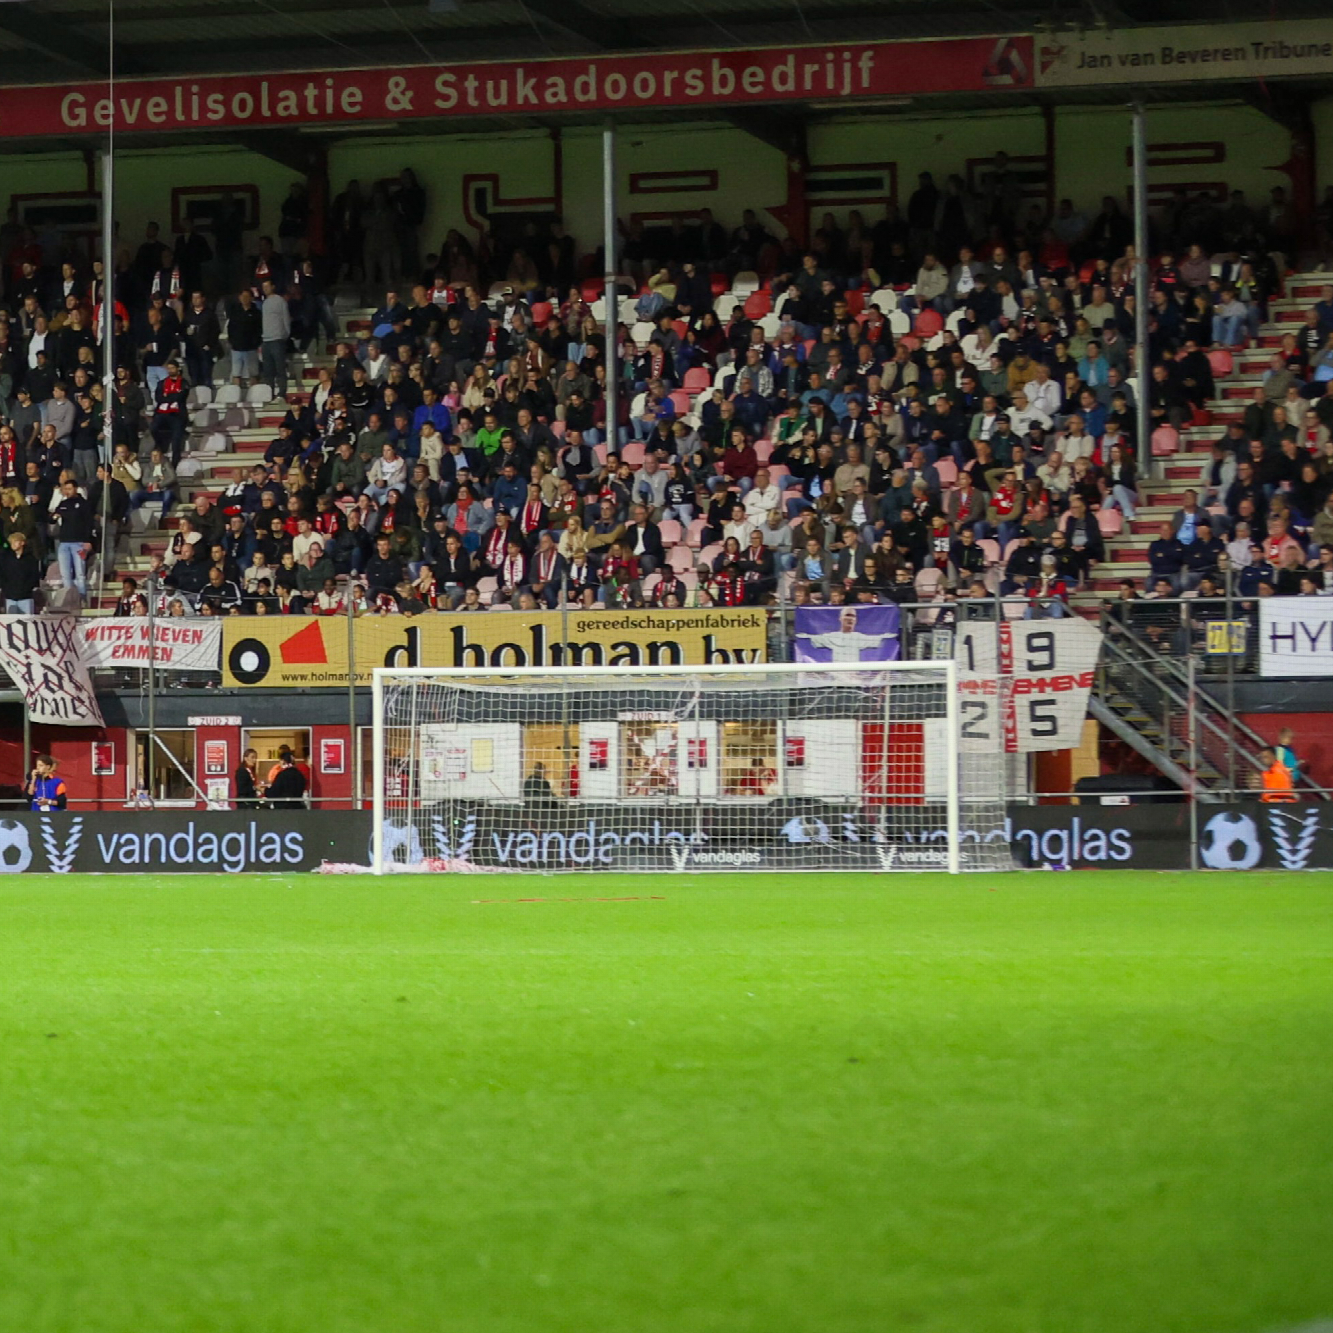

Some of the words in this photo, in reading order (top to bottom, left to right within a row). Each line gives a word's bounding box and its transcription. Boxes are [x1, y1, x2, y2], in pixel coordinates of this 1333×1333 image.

[1077, 51, 1111, 69] Jan
[1118, 52, 1155, 67] van
[1161, 43, 1247, 65] Beveren
[1250, 40, 1333, 61] Tribune
[61, 78, 363, 128] Gevelisolatie
[385, 75, 414, 110] &
[435, 51, 876, 109] Stukadoorsbedrijf
[85, 625, 134, 643] WITTE
[140, 626, 203, 644] WIEVEN
[577, 614, 761, 633] gereedschappenfabriek
[1269, 620, 1333, 653] HY
[111, 644, 173, 662] EMMEN
[451, 624, 685, 667] holman
[703, 634, 762, 666] bv
[963, 634, 975, 671] 1
[1026, 631, 1055, 672] 9
[200, 718, 222, 726] ZUID
[961, 700, 990, 739] 2
[1029, 699, 1058, 737] 5
[97, 820, 305, 874] vandaglas
[692, 849, 761, 866] vandaglas
[898, 850, 969, 865] vandagas
